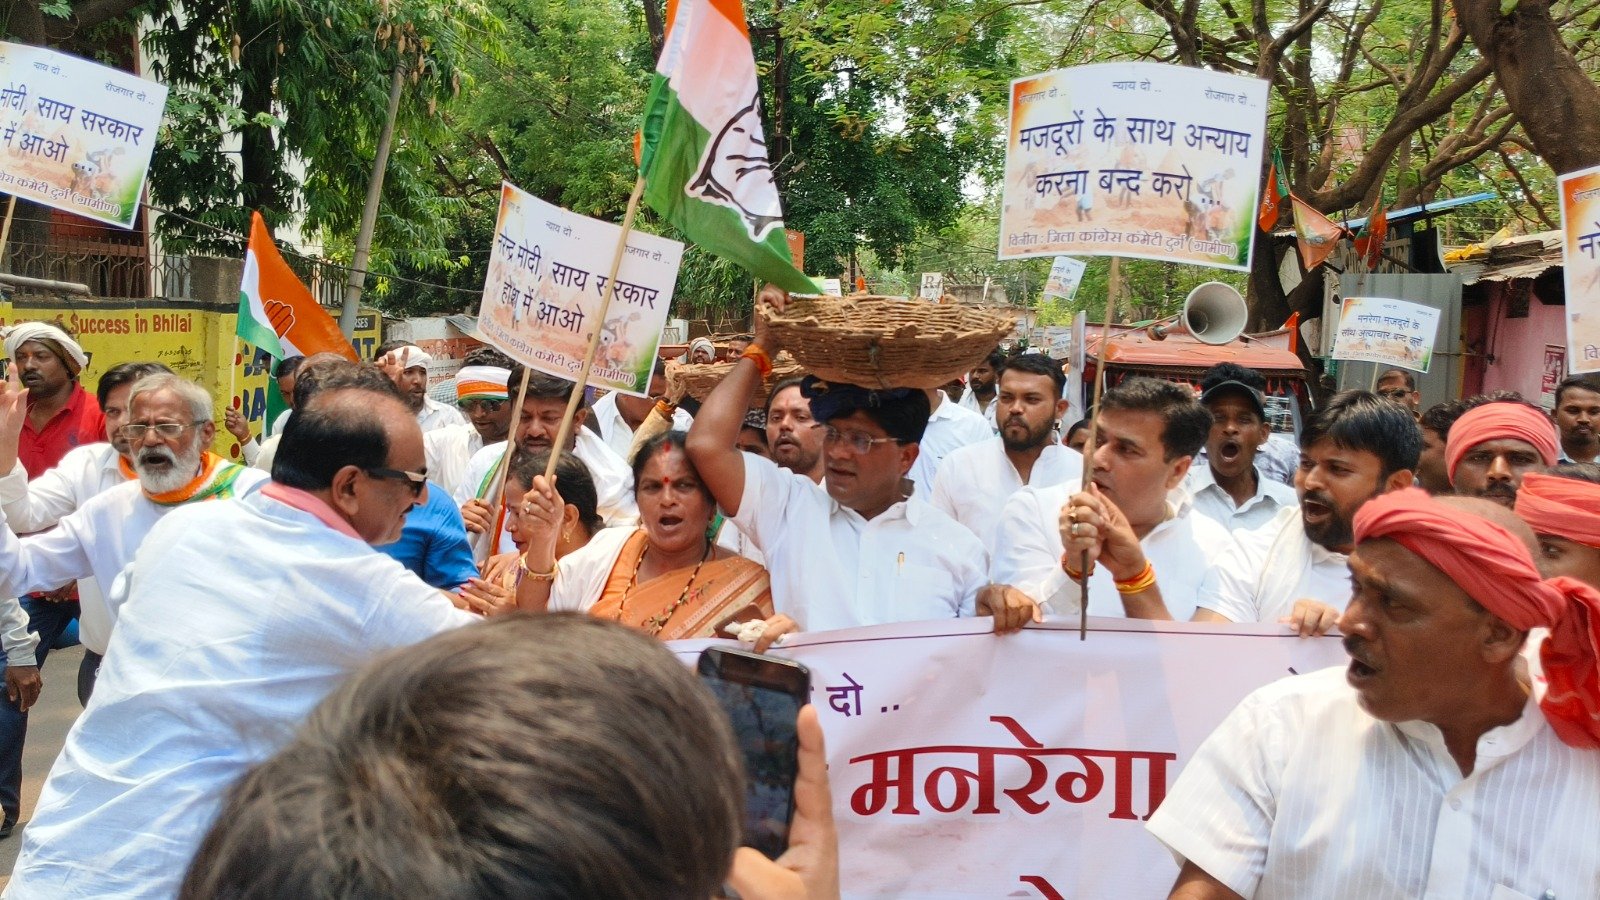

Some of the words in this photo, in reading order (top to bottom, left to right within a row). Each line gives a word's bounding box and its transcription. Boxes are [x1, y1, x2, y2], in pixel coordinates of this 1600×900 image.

[1112, 81, 1136, 91] न्याय
[1140, 78, 1151, 92] दो
[1204, 86, 1236, 104] रोजगार
[38, 96, 76, 124] साय
[81, 109, 144, 146] सरकार
[1019, 108, 1084, 156] मजदूरों
[1093, 107, 1116, 144] के
[1126, 116, 1176, 147] साथ
[1185, 123, 1251, 159] अन्याय
[4, 121, 17, 148] में
[19, 133, 69, 163] आओ
[1035, 169, 1090, 198] करना
[1098, 168, 1143, 196] बन्द
[1151, 164, 1193, 202] करो
[1079, 227, 1123, 243] कांग्रेस
[552, 261, 590, 292] साय
[70, 313, 130, 334] Success
[135, 313, 148, 334] in
[152, 313, 192, 333] Bhilai
[523, 285, 534, 316] में
[537, 303, 584, 334] आओ
[826, 672, 864, 717] दो
[849, 715, 1177, 822] मनरेगा
